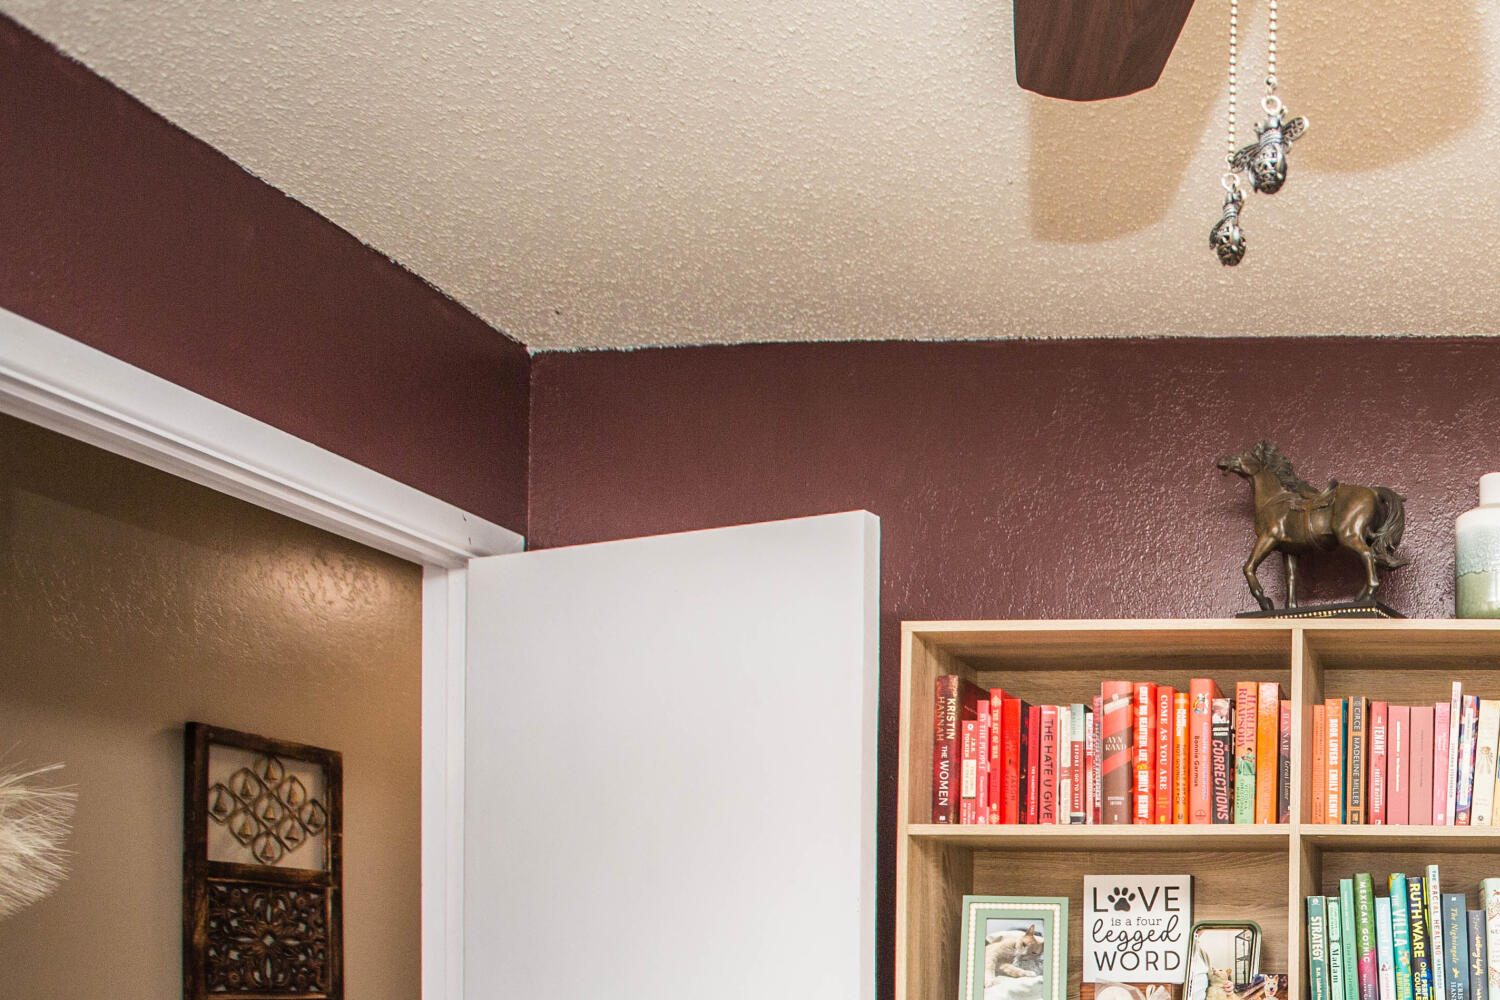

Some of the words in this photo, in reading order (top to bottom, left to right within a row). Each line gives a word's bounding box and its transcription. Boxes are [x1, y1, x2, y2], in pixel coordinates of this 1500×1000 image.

[936, 696, 945, 741] HANNAH
[946, 697, 957, 740] KRISTIN
[1159, 694, 1169, 724] COME
[1237, 688, 1248, 749] RHAPSODY
[1245, 694, 1257, 744] HARLEM
[1353, 707, 1362, 730] CIRCE
[1043, 719, 1054, 741] THE
[1159, 728, 1168, 743] AS
[1328, 718, 1339, 737] BOOK
[1374, 725, 1385, 755] TENANT
[940, 745, 948, 759] THE
[1043, 745, 1054, 776] HATE
[1159, 745, 1168, 767] YOU
[1328, 739, 1339, 766] LOVERS
[1352, 737, 1361, 776] MADELINE
[938, 760, 949, 806] WOMEN
[1043, 779, 1053, 788] U
[1137, 770, 1149, 793] EMILY
[1158, 770, 1168, 791] ARE
[1212, 739, 1229, 821] CORRECTIONS
[1328, 768, 1339, 791] EMILY
[1351, 779, 1361, 806] MILLER
[1043, 791, 1053, 819] GIVE
[1137, 794, 1149, 819] HENRY
[1328, 793, 1339, 818] HENRY
[1359, 881, 1369, 924] MEXICAN
[1409, 883, 1422, 922] RUTH
[1092, 915, 1182, 952] legged
[1111, 917, 1122, 926] is
[1125, 918, 1133, 926] a
[1136, 917, 1163, 926] four
[1361, 928, 1371, 964] GOTHIC
[1412, 922, 1426, 958] WARE
[1093, 951, 1181, 972] WORD
[1331, 948, 1340, 984] Madam
